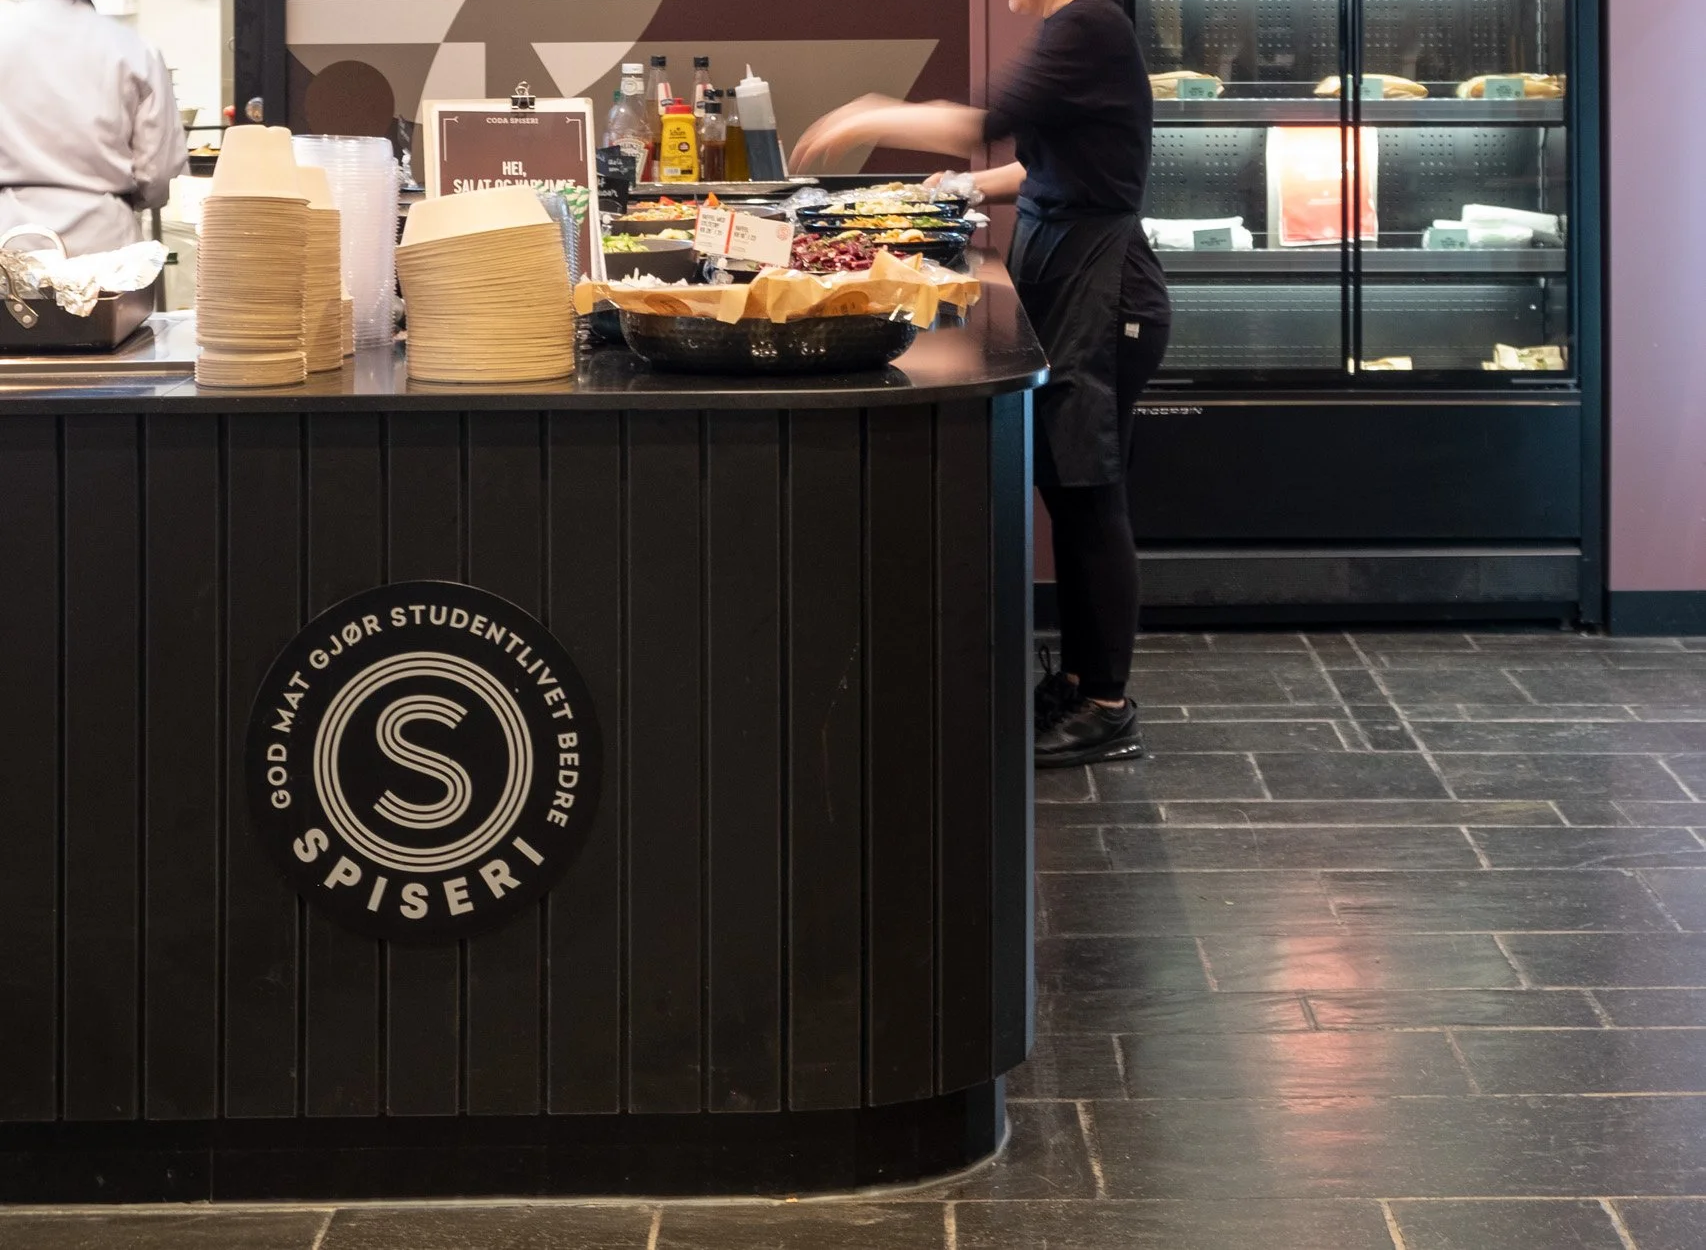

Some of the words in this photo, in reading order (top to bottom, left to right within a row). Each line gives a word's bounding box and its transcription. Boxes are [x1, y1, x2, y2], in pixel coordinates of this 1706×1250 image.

[502, 161, 527, 178] HEI,
[308, 614, 383, 670] GJØR
[391, 604, 574, 721] STUDENTLIVET
[271, 670, 311, 734] MAT
[266, 743, 292, 810] GOD
[546, 731, 580, 829] BEDRE
[292, 827, 546, 920] SPISERI
